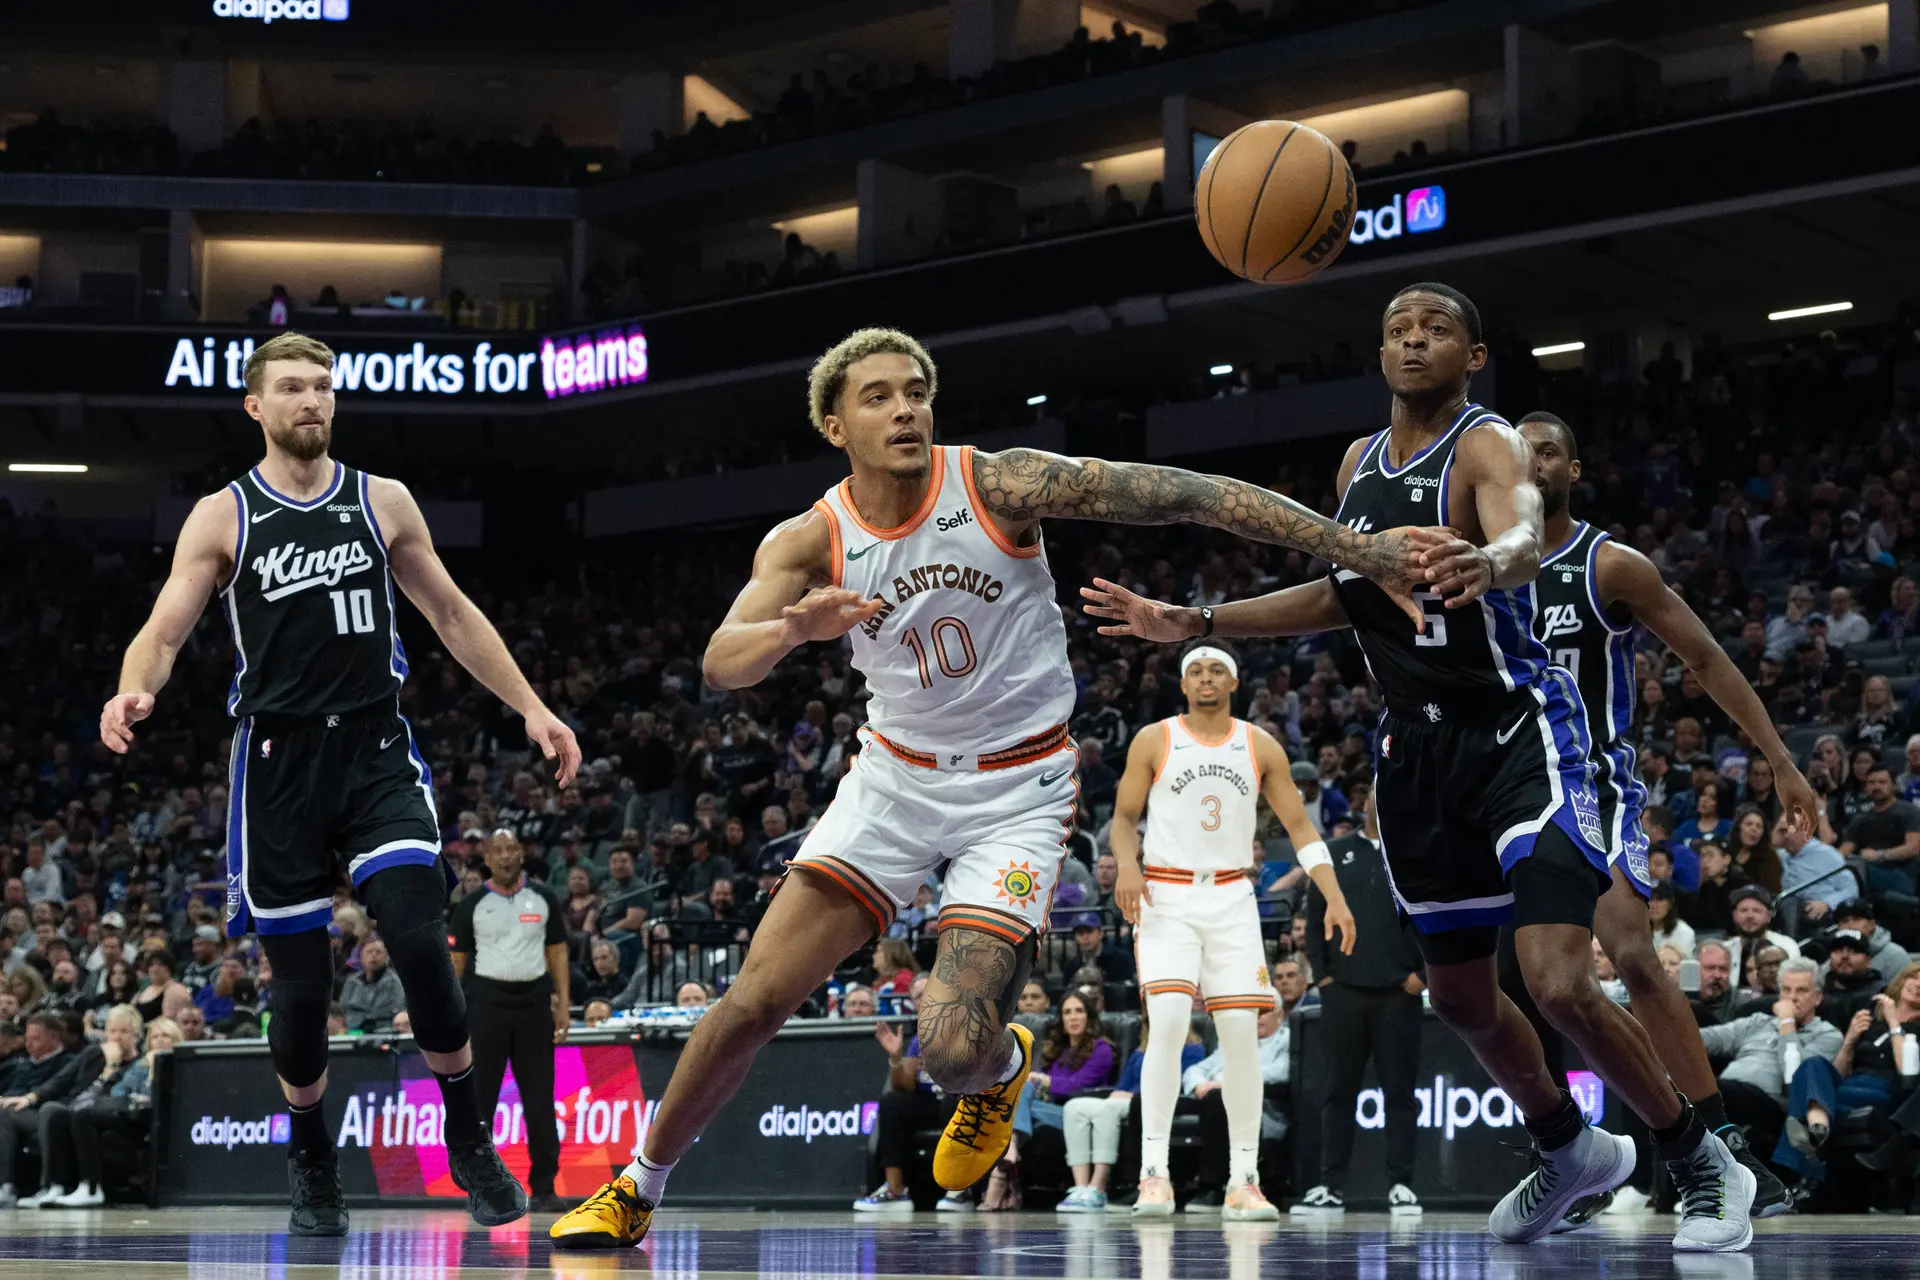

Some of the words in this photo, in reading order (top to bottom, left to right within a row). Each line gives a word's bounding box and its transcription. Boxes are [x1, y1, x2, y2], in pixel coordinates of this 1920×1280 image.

[165, 337, 215, 387] Ai
[332, 341, 464, 394] works
[473, 341, 536, 393] for
[540, 333, 648, 398] teams
[1404, 475, 1439, 488] dialpad
[327, 504, 360, 515] dialpad
[936, 508, 973, 532] Self.
[252, 540, 373, 602] Kings
[892, 563, 1003, 603] ANTONIO
[1552, 563, 1585, 573] dialpad
[329, 588, 375, 635] 10
[1410, 592, 1448, 647] 5
[900, 616, 977, 690] 10
[1171, 769, 1196, 795] SAN
[1199, 764, 1249, 796] ANTONIO
[1200, 795, 1222, 832] 3
[1579, 813, 1603, 829] KIN
[191, 1115, 271, 1150] dialpad
[337, 1092, 375, 1147] Ai
[574, 1086, 628, 1144] for
[759, 1103, 860, 1144] dialpad
